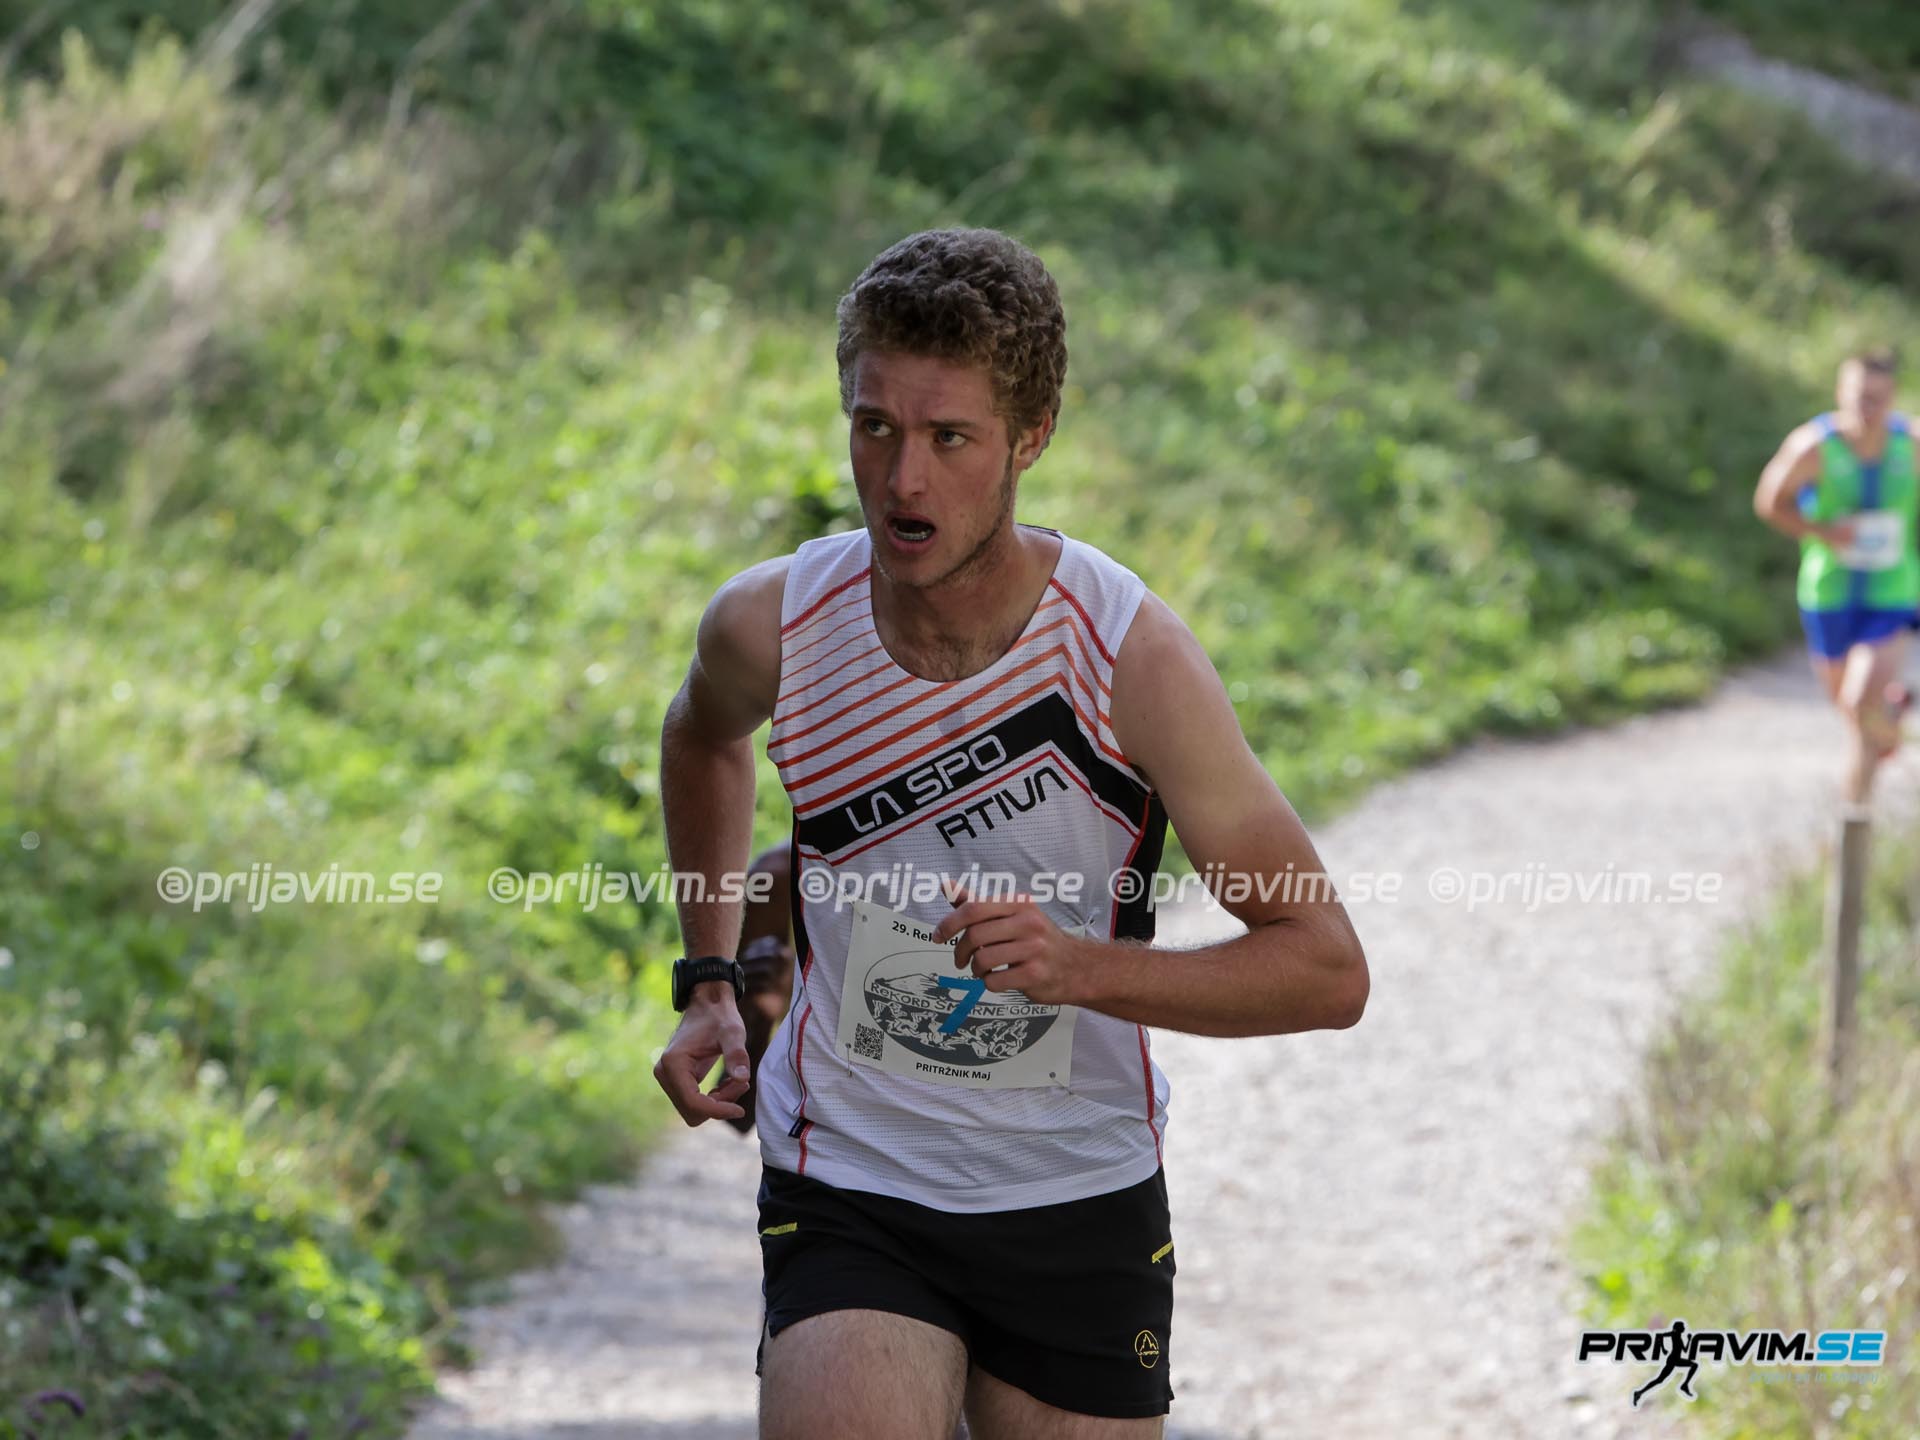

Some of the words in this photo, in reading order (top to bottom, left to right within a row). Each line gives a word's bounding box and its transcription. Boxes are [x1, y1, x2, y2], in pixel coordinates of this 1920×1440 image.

[844, 791, 904, 834] LA
[905, 734, 1007, 807] SPO
[935, 766, 1069, 848] RTIVA
[891, 920, 910, 937] 29.
[937, 975, 986, 1035] 7
[915, 1062, 970, 1079] PRITRŽNIK
[971, 1070, 992, 1081] Maj
